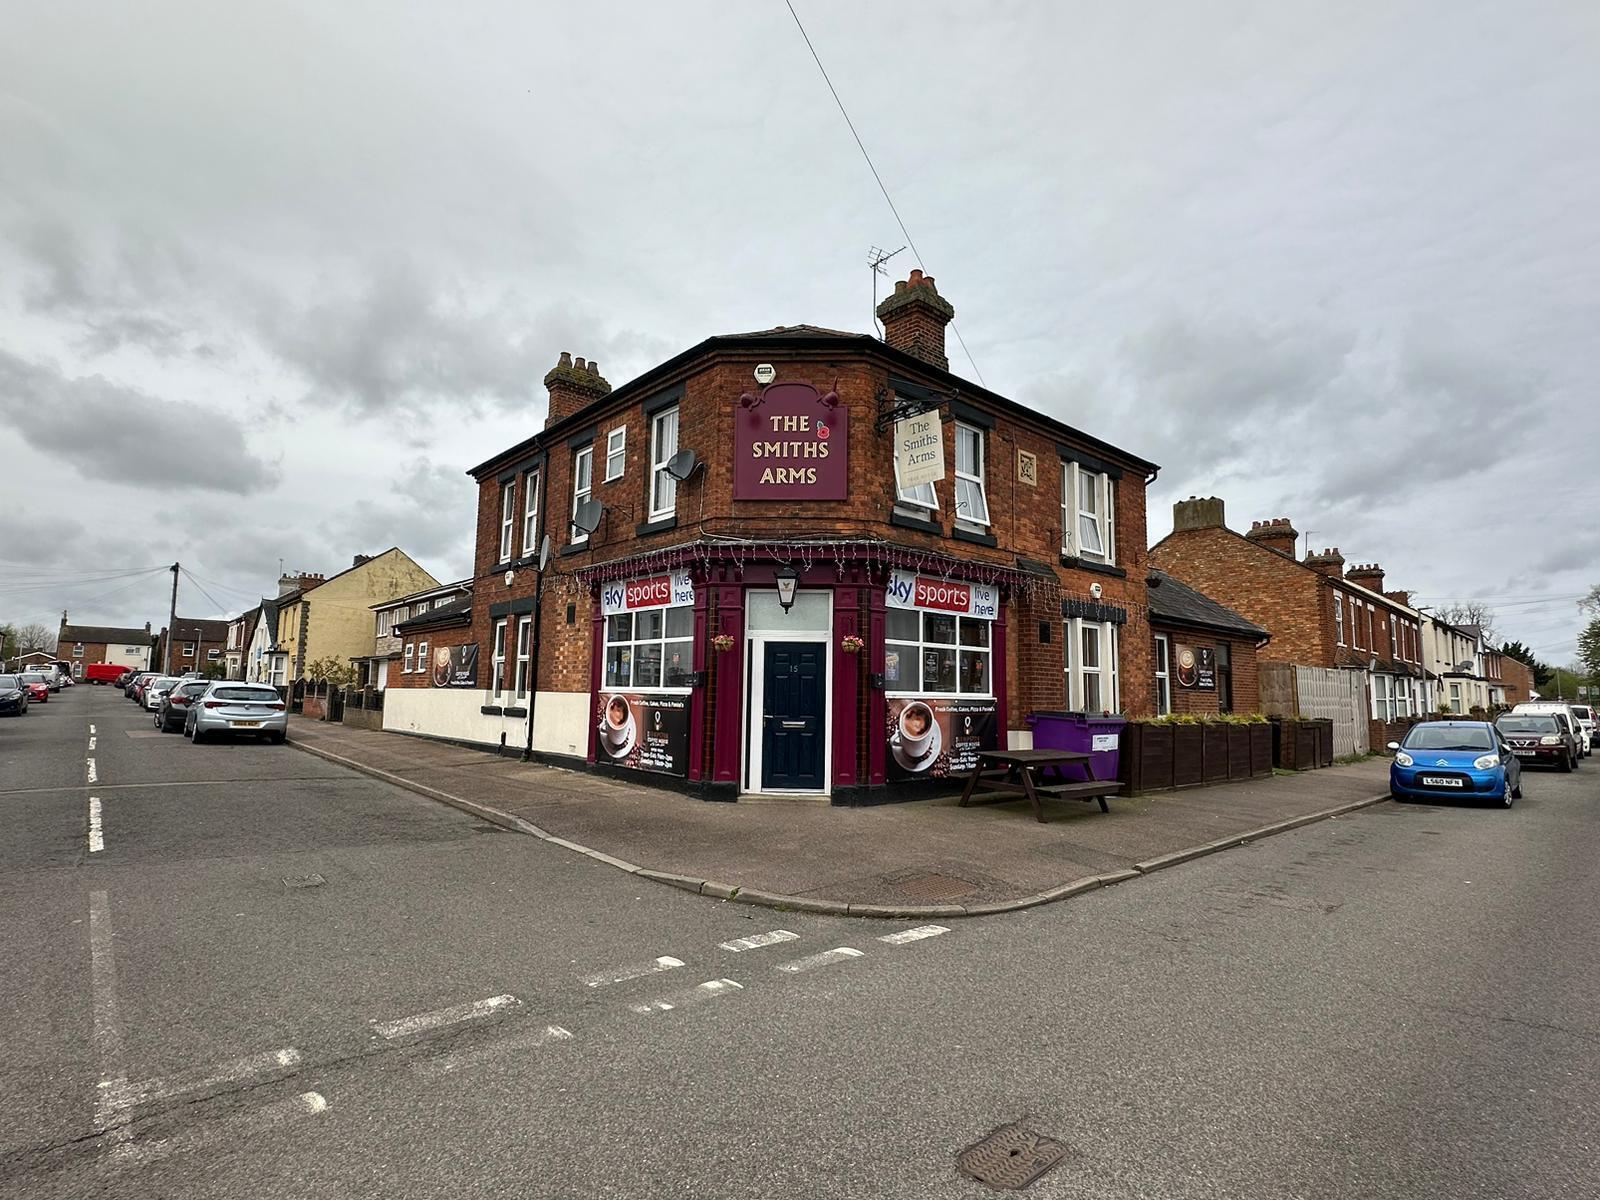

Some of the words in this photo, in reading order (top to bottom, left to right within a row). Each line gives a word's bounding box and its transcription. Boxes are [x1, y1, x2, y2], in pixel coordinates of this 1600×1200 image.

[769, 415, 810, 432] THE
[909, 421, 930, 435] The
[752, 441, 829, 458] SMITHS
[903, 433, 938, 453] Smiths
[907, 450, 936, 467] Arms
[759, 467, 817, 485] ARMS
[674, 574, 690, 587] live
[604, 586, 624, 608] sky
[627, 582, 669, 605] sports
[674, 589, 694, 602] here
[918, 584, 967, 606] sports
[974, 586, 990, 600] live
[974, 603, 994, 616] here
